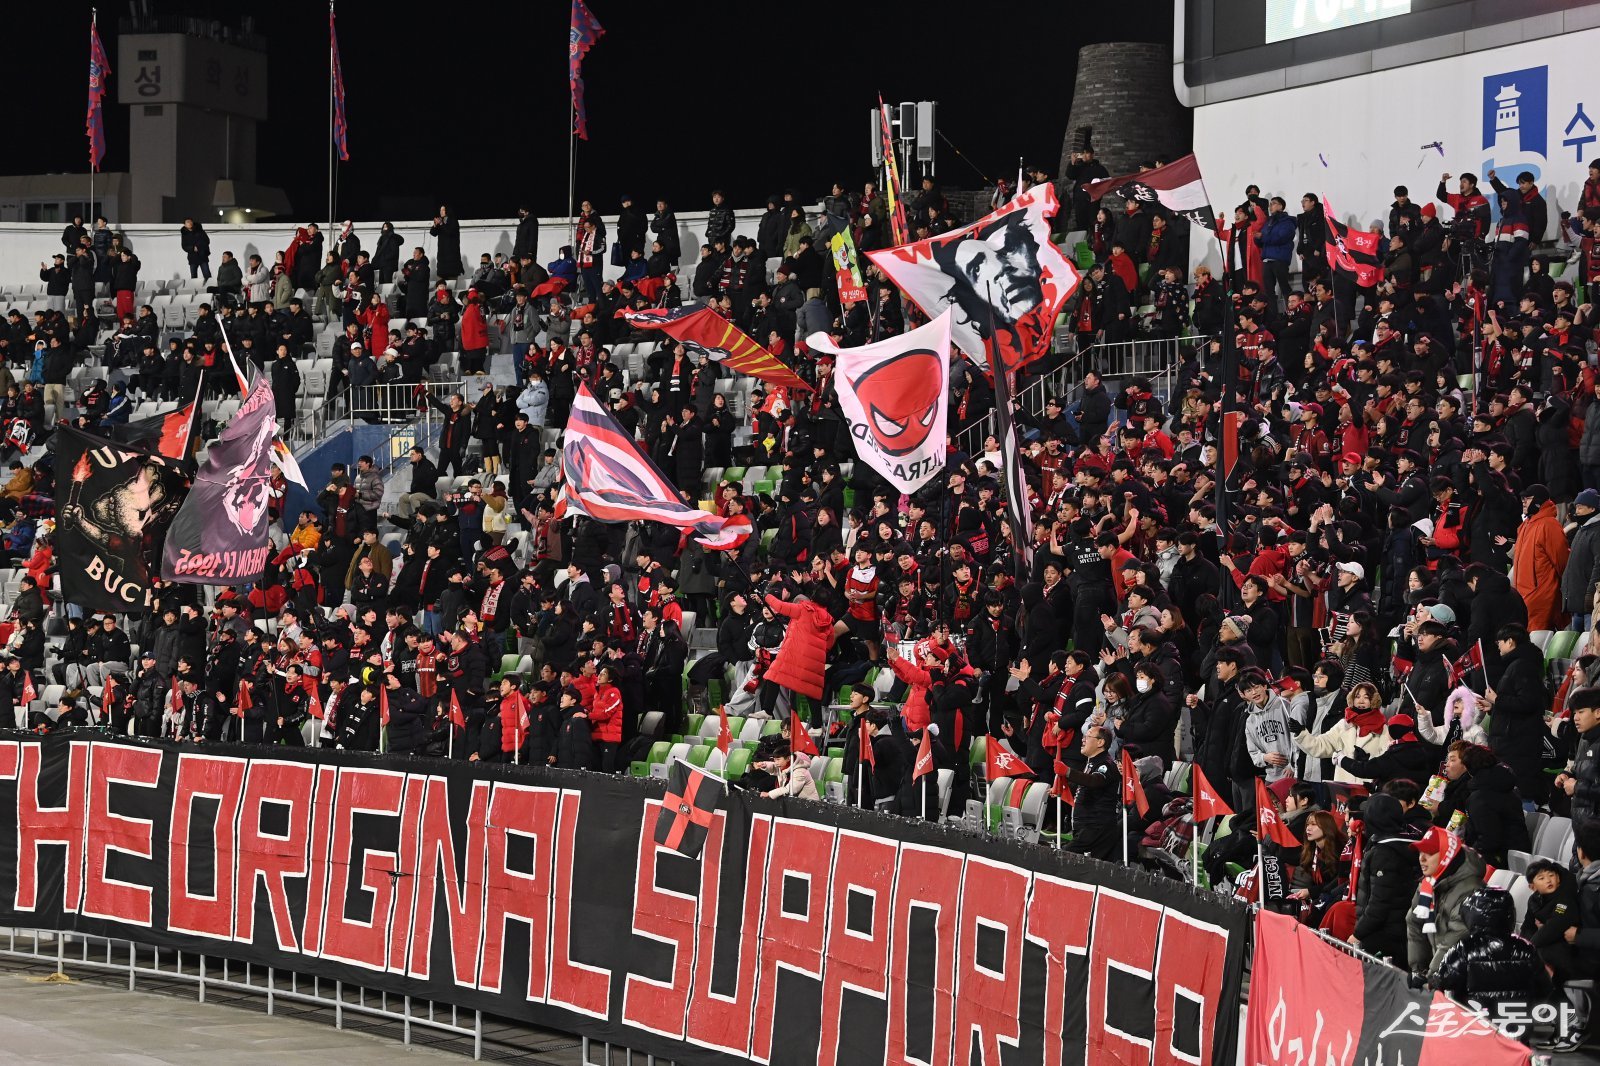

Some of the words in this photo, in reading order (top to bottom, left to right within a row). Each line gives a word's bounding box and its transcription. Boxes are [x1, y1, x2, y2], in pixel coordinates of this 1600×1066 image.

[134, 65, 161, 97] 성
[1562, 102, 1598, 163] 수
[0, 740, 164, 928] HE
[167, 752, 612, 1021] ORIGINAL
